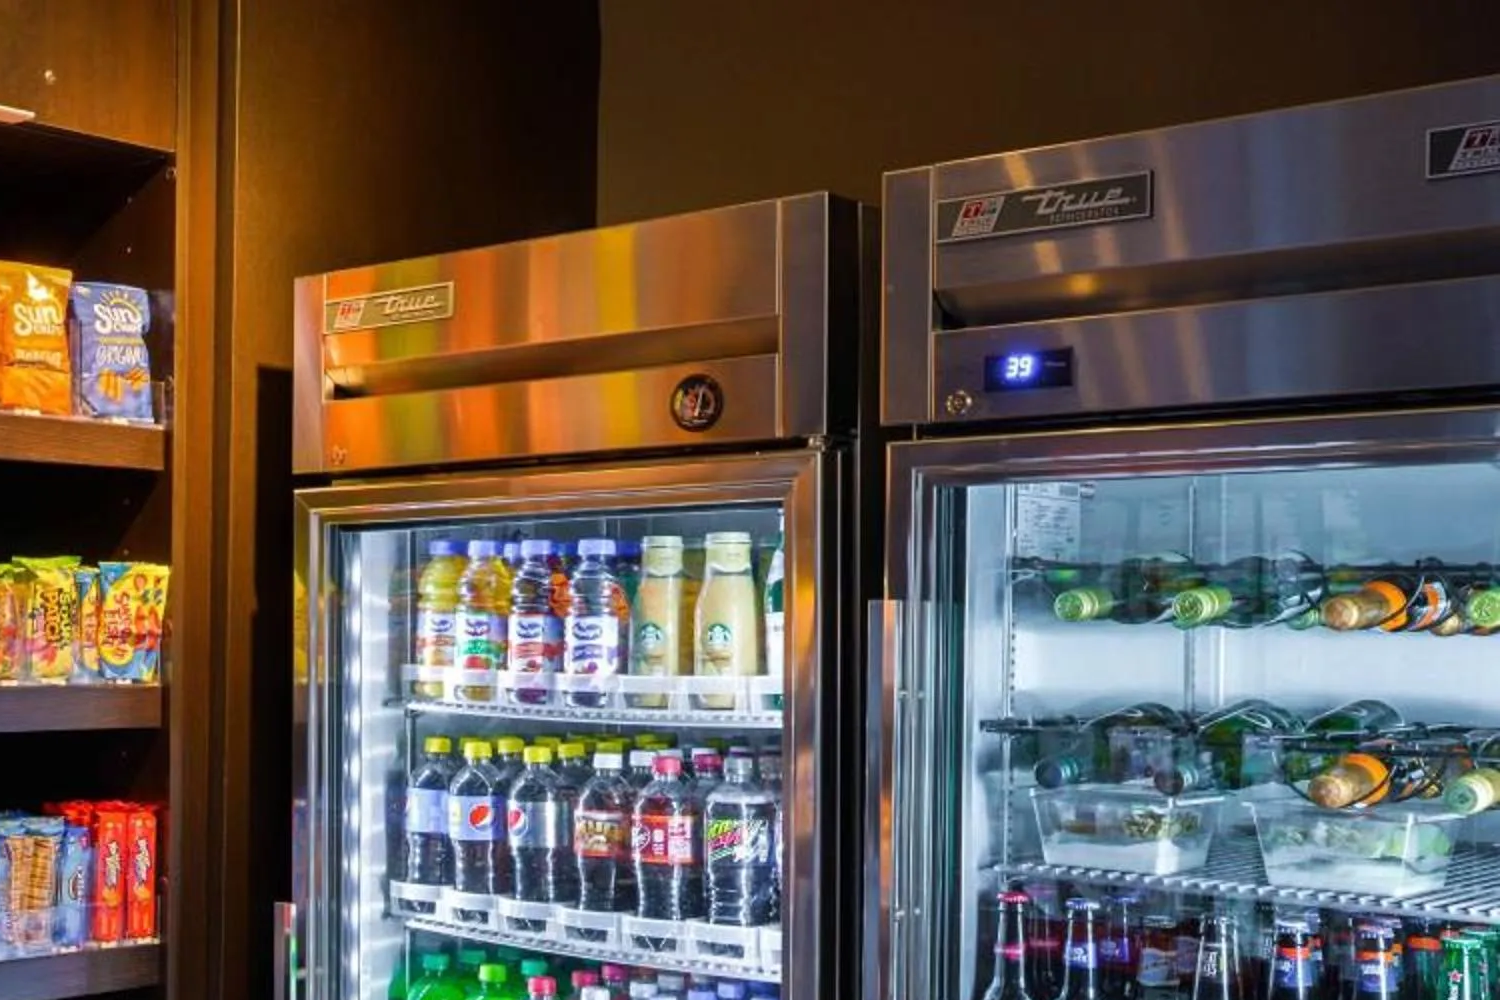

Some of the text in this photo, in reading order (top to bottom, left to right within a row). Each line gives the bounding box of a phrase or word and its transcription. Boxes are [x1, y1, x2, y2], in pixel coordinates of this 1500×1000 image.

[1022, 186, 1131, 215] True
[13, 302, 62, 336] Sun
[94, 303, 141, 334] Sun
[1006, 356, 1032, 378] 39
